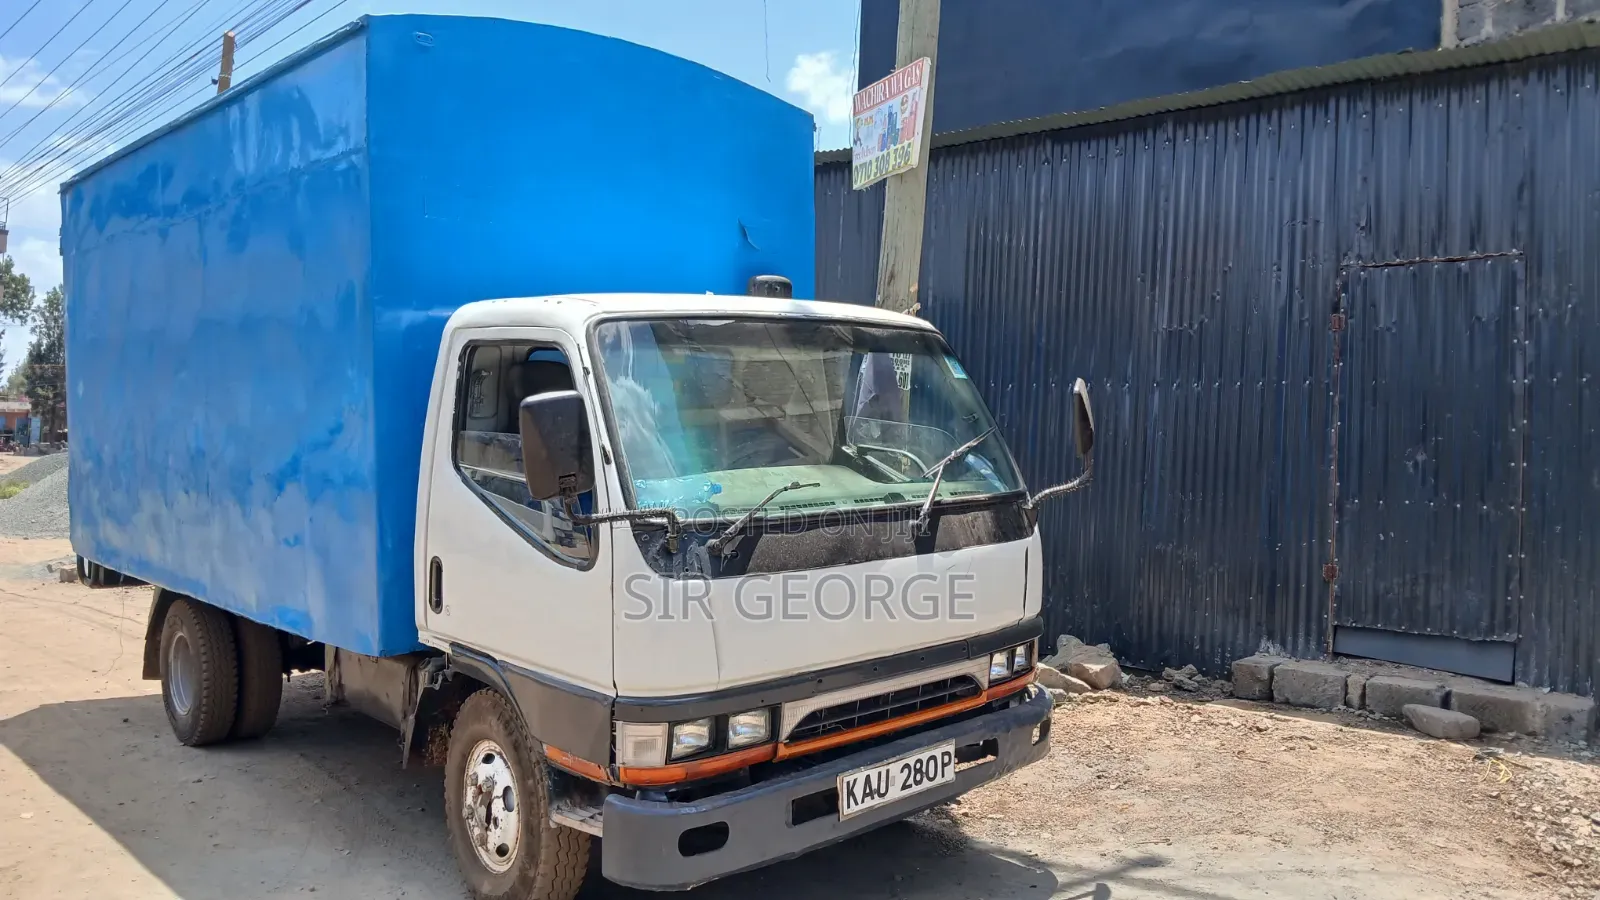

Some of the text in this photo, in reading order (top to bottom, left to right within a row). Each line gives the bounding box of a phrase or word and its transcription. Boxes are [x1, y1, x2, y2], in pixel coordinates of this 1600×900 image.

[855, 77, 889, 113] WACHIRA
[904, 61, 921, 88] GAS
[874, 152, 890, 177] 308
[892, 142, 912, 169] 396
[846, 751, 952, 809] KAU 280P
